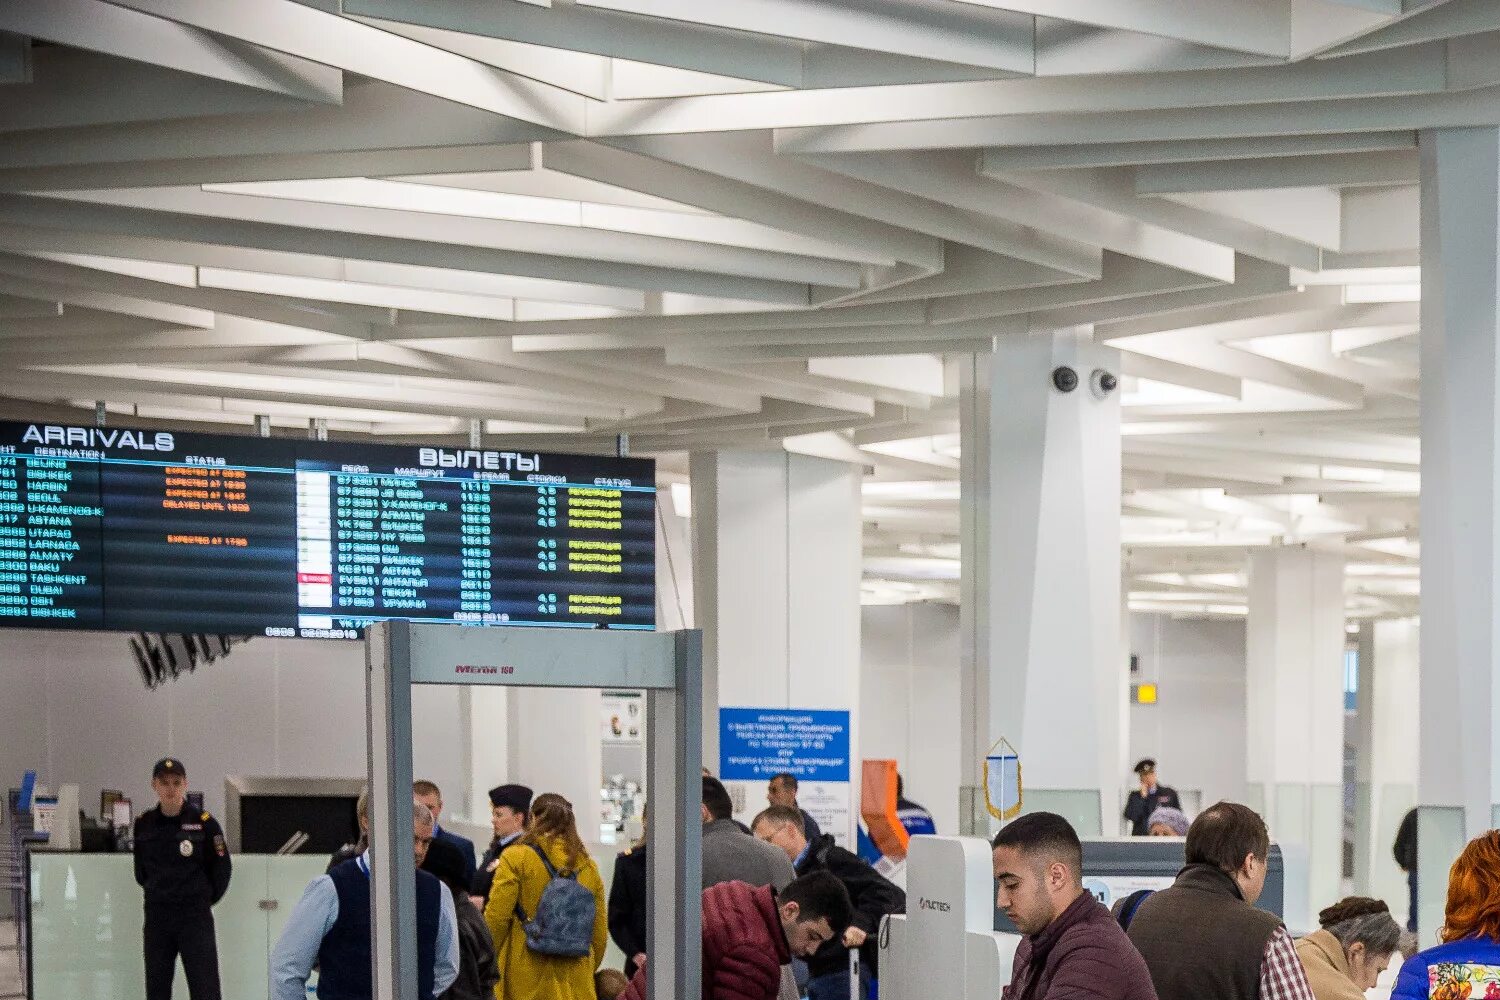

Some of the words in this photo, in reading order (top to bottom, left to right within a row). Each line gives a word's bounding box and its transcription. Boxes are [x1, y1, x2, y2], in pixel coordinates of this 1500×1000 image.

[22, 424, 175, 452] ARRIVALS
[0, 445, 16, 454] HT
[34, 446, 105, 459] DESTINATION
[26, 459, 67, 469] BEIJING
[185, 456, 226, 466] STATUS
[419, 447, 540, 472] ВЫЛЕТЫ
[26, 469, 72, 481] BISHKEK
[27, 481, 68, 492] HARBIN
[28, 493, 62, 504] SEOUL
[28, 515, 72, 526] ASTANA
[29, 540, 81, 551] LARNACA
[29, 551, 74, 562] ALMATY
[30, 562, 60, 573] BAKU
[30, 574, 88, 585] TASHKENT
[30, 585, 63, 595] DUBAI
[31, 608, 77, 618] BISHKEK
